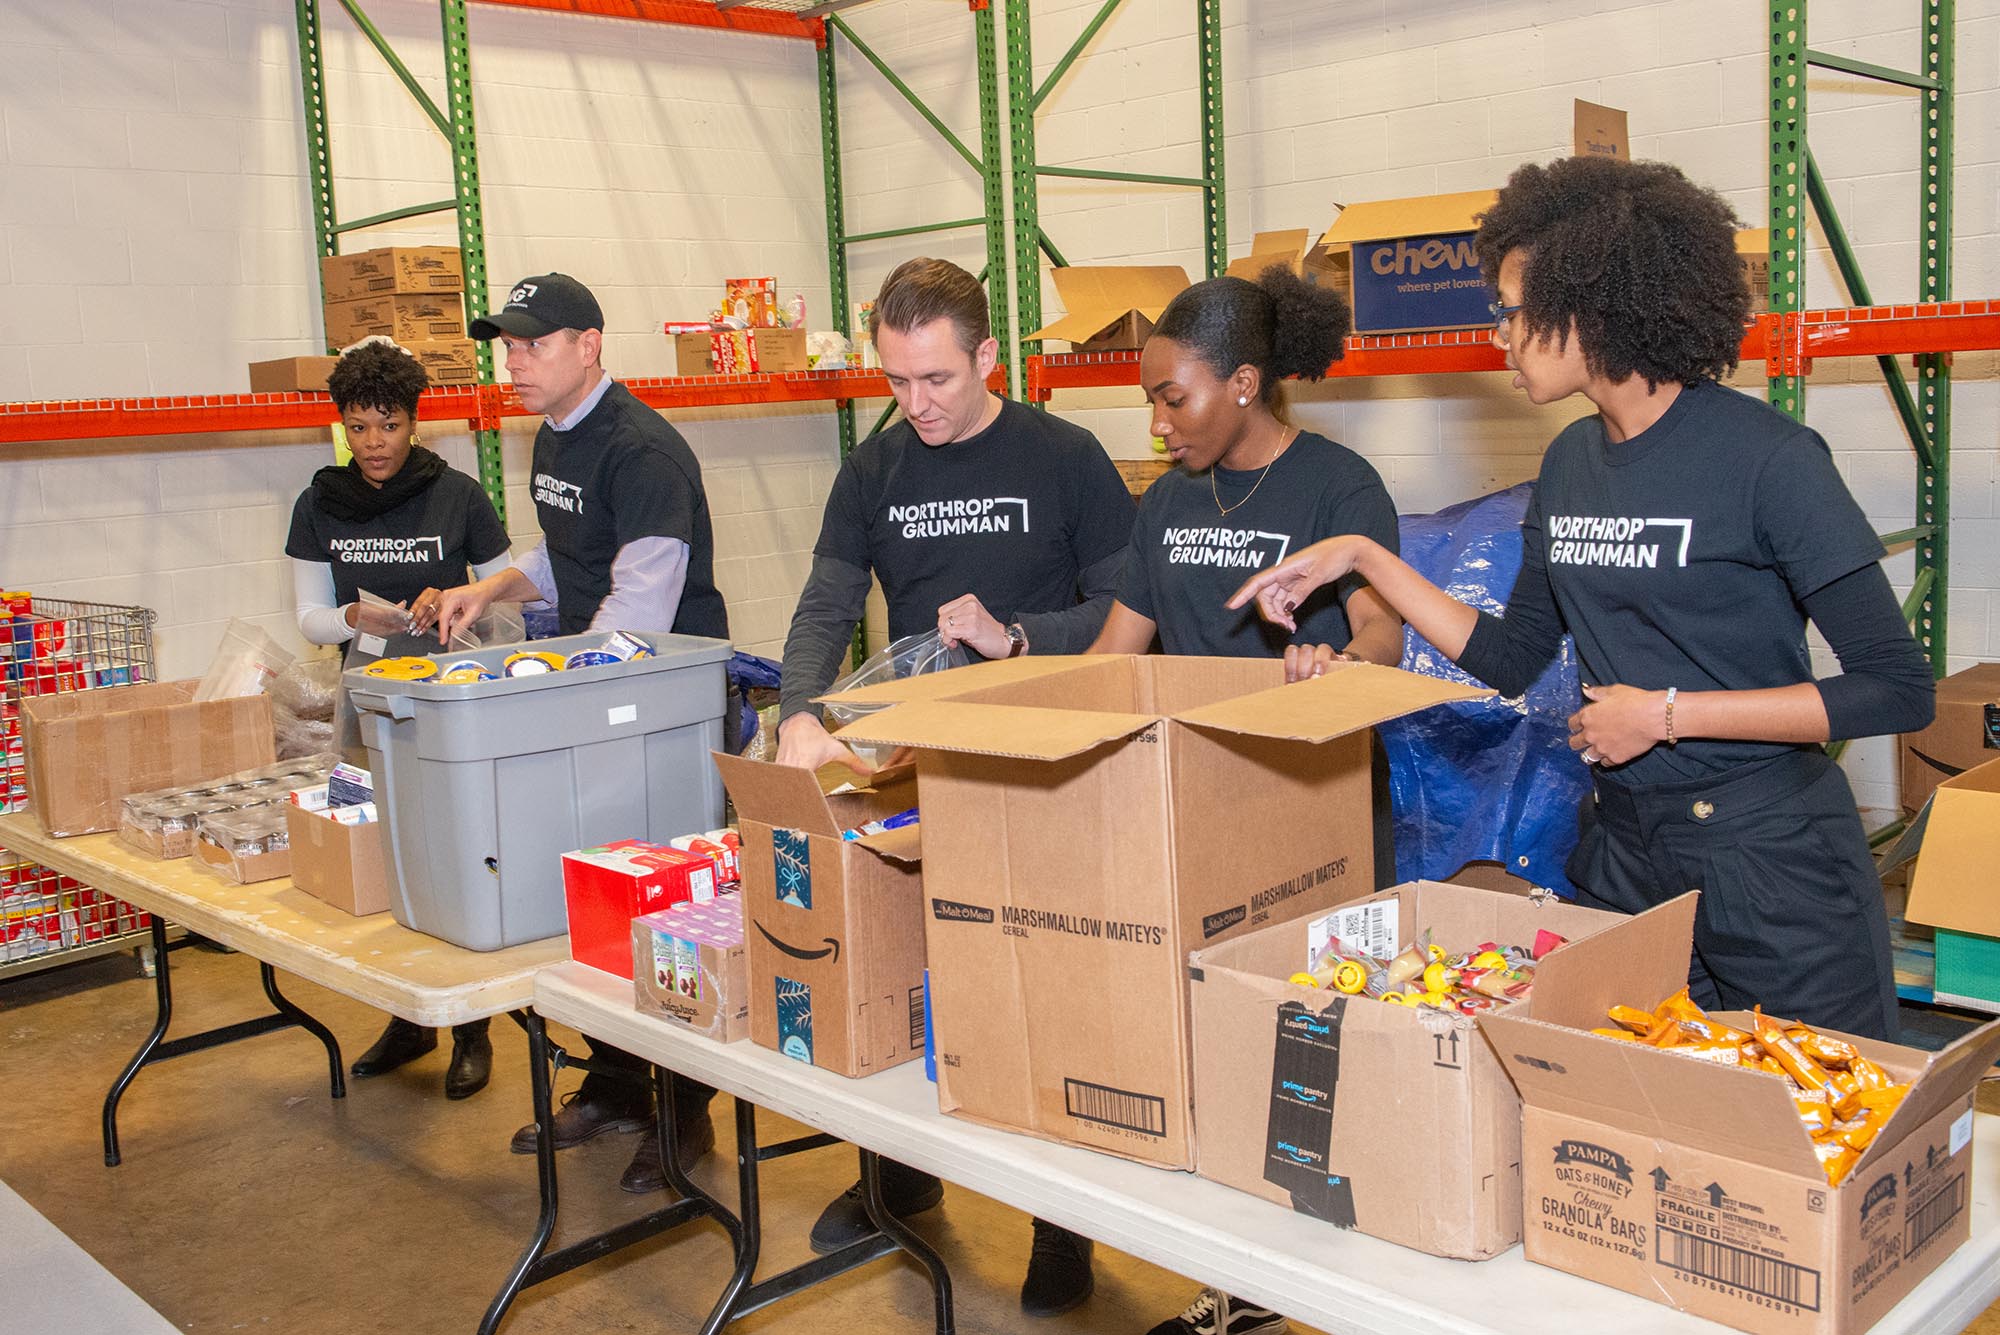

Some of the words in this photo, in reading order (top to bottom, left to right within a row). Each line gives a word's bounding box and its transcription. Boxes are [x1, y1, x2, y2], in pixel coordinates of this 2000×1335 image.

[1371, 240, 1484, 275] chew
[1397, 281, 1432, 293] where
[1434, 281, 1450, 292] pet
[1453, 279, 1487, 289] lovers
[534, 473, 568, 494] NRTROP
[889, 499, 994, 522] NORTHROP
[902, 515, 1010, 539] GRUMMAN
[1162, 527, 1257, 547] NORTHROP
[330, 538, 416, 551] NORTHROP
[1550, 540, 1659, 568] GRUMMAN
[340, 551, 429, 563] GRUMMAN
[1168, 545, 1265, 568] GRUMMAN
[1251, 871, 1314, 913] MARSHMALLOW
[1002, 906, 1101, 938] MARSHMALLOW
[1003, 925, 1029, 938] CEREAL
[1284, 1018, 1308, 1030] pantry
[1308, 1024, 1329, 1034] prime
[1282, 1081, 1303, 1092] prime
[1304, 1087, 1328, 1100] pantry
[1125, 1131, 1148, 1142] 27596
[1277, 1141, 1298, 1153] prime
[1298, 1148, 1322, 1161] pantry
[1567, 1144, 1617, 1168] PAMPA
[1556, 1168, 1582, 1182] OATS
[1584, 1173, 1592, 1183] &
[1593, 1173, 1632, 1199] HONEY
[1574, 1191, 1613, 1219] Chewy
[1661, 1199, 1715, 1222] FRAGILE
[1542, 1197, 1603, 1231] GRANOLA
[1611, 1217, 1646, 1247] BARS
[1722, 1212, 1767, 1230] DISTRIBUTED
[1544, 1221, 1553, 1231] 12
[1562, 1227, 1575, 1237] 4.5
[1577, 1232, 1588, 1241] OZ
[1590, 1235, 1604, 1246] (12
[1722, 1236, 1750, 1248] PRODUCT
[1751, 1243, 1760, 1251] OF
[1761, 1246, 1784, 1258] MEXICO
